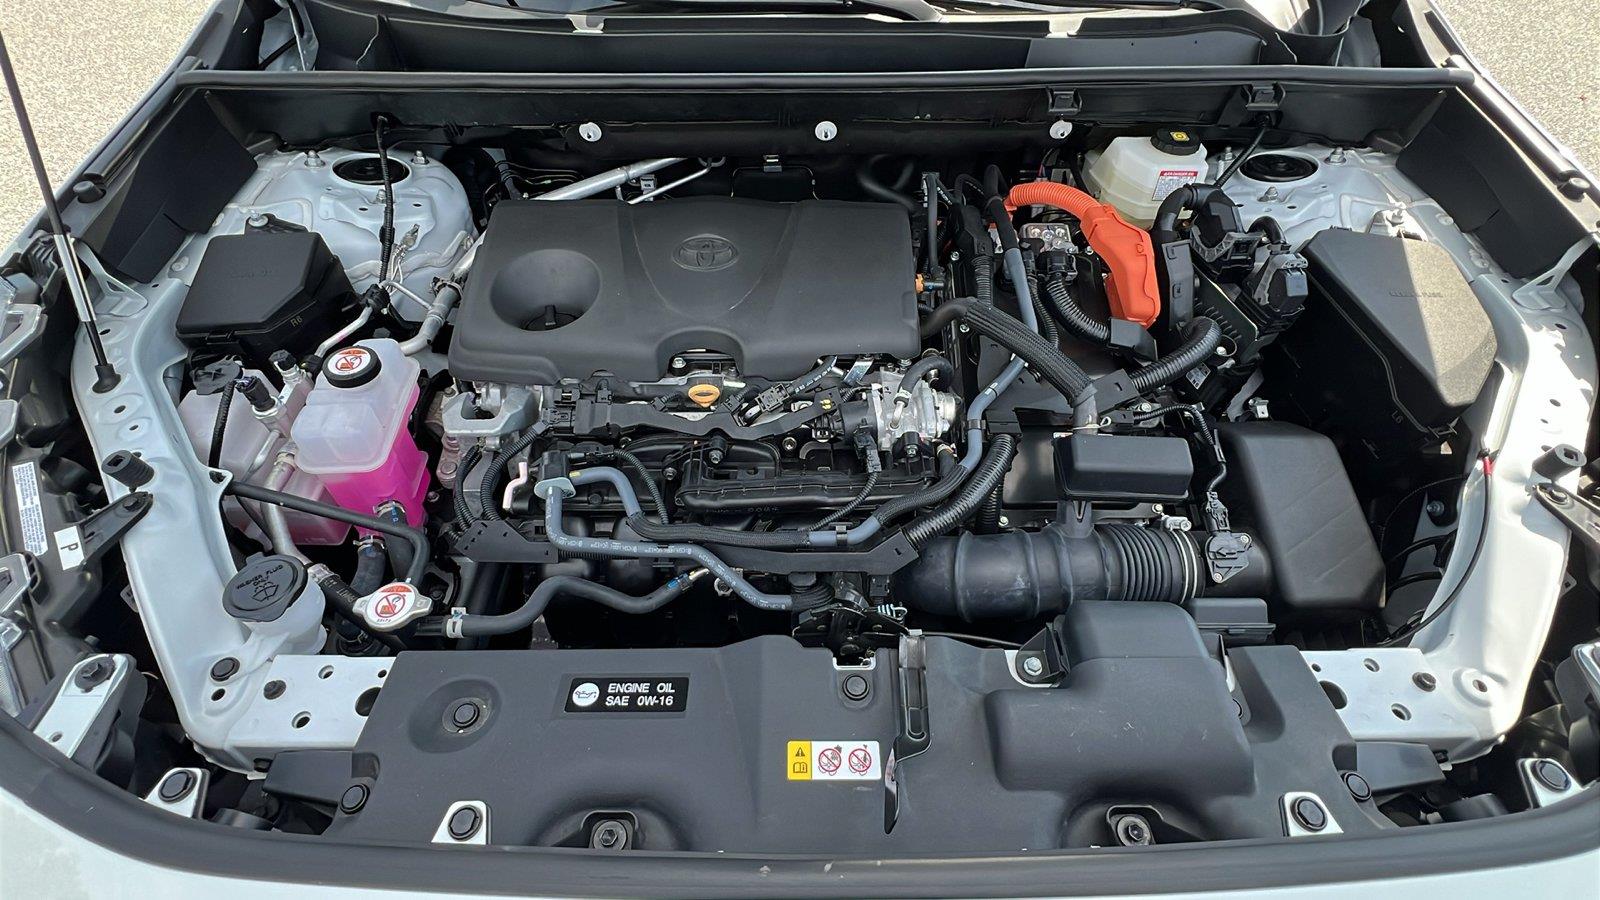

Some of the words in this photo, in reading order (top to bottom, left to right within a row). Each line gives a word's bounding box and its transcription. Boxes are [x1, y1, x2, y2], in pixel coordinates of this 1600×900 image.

[60, 542, 79, 551] P
[607, 682, 650, 694] ENGINE
[656, 682, 676, 694] OIL
[605, 695, 630, 707] SAE
[636, 695, 674, 707] 0W-16
